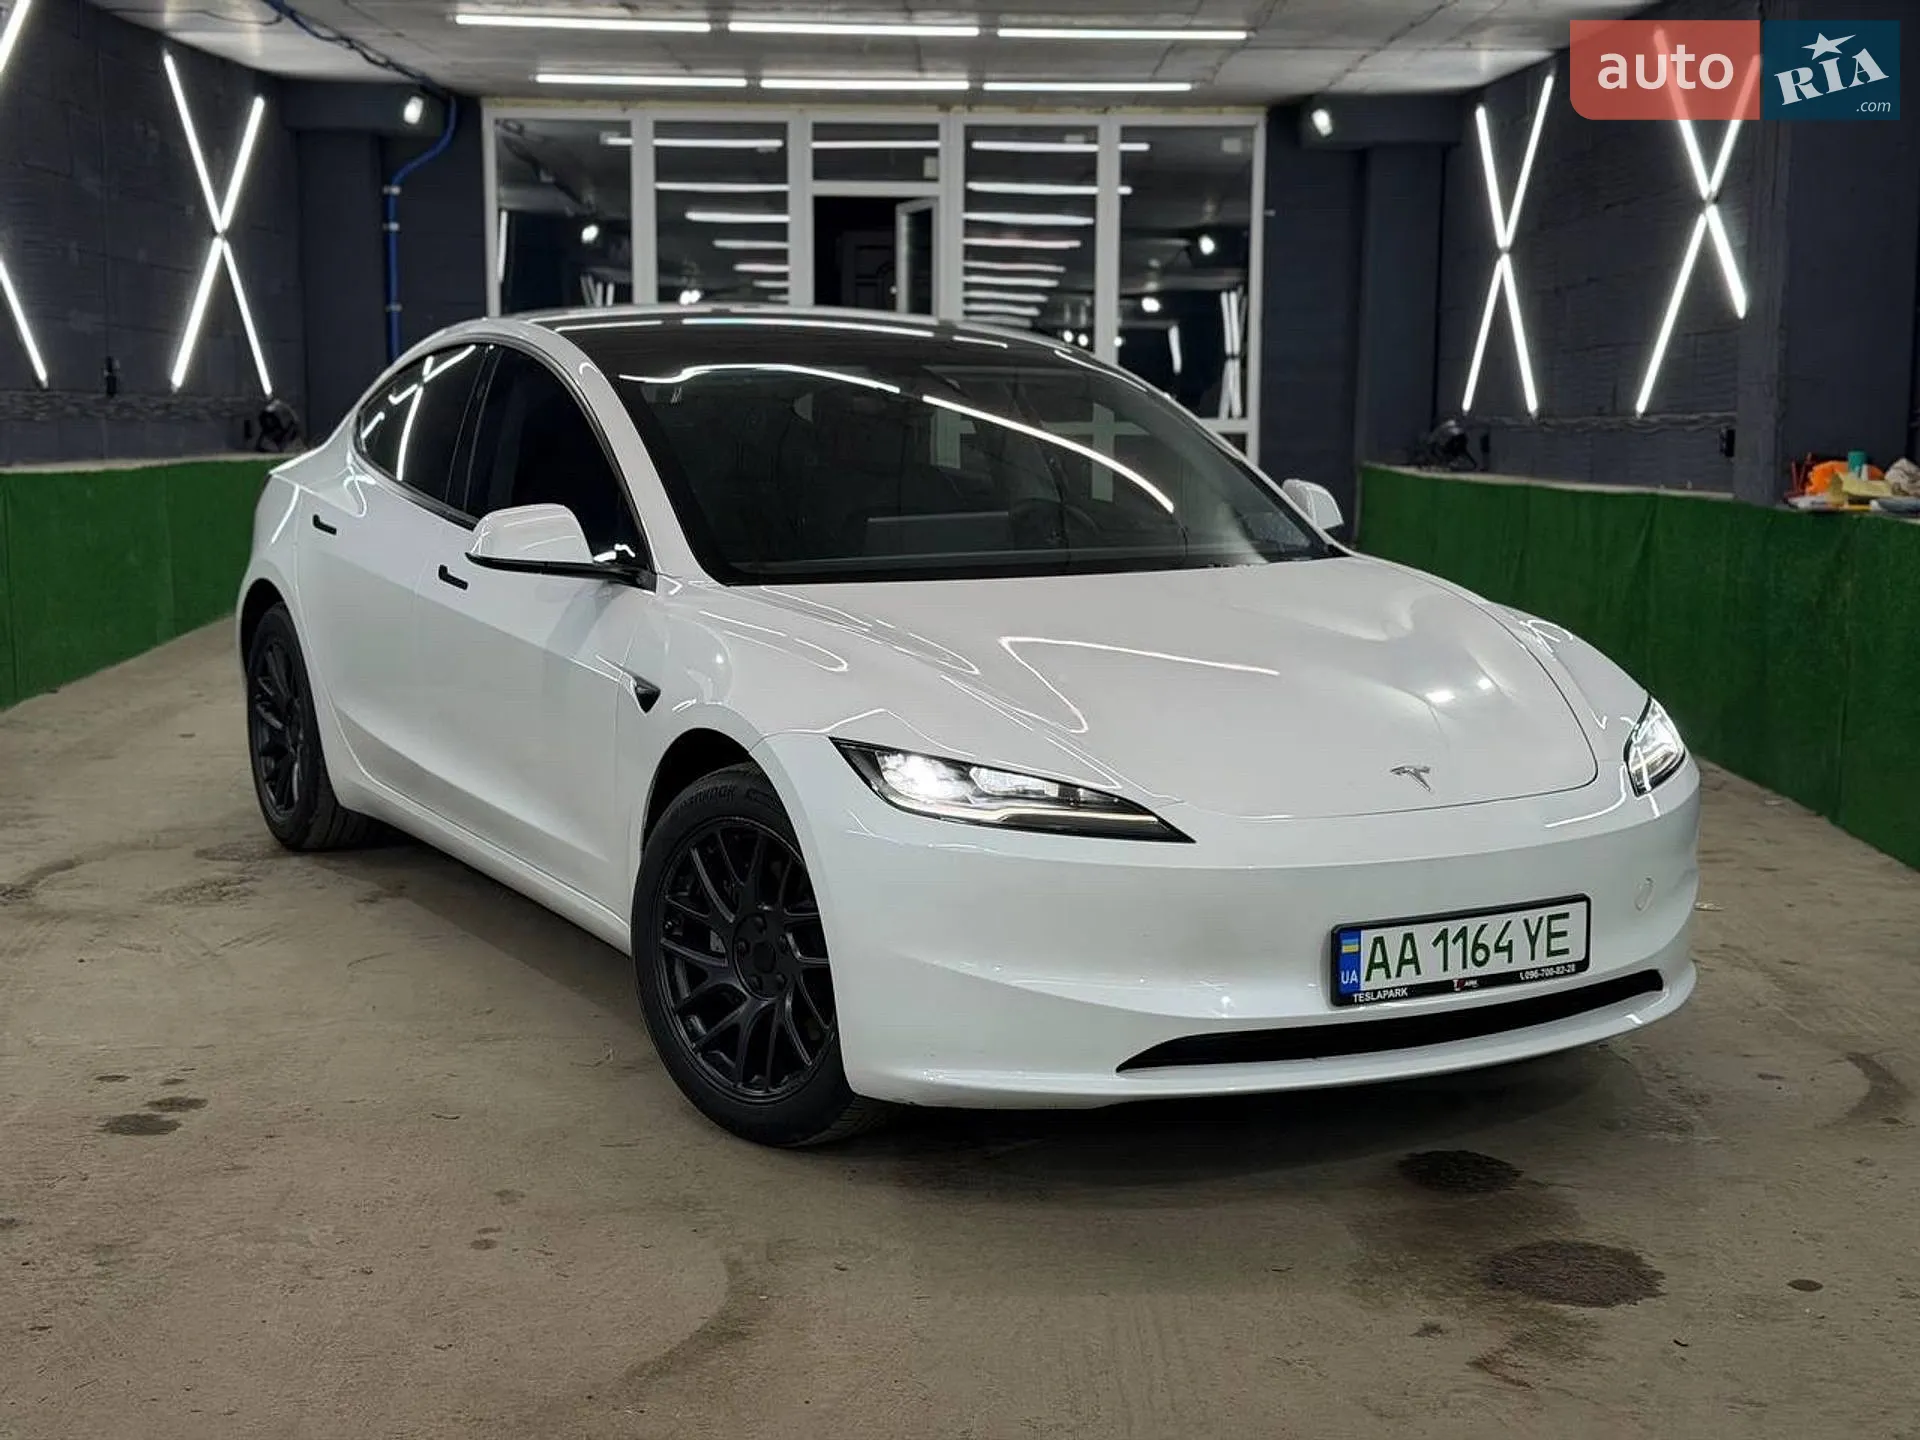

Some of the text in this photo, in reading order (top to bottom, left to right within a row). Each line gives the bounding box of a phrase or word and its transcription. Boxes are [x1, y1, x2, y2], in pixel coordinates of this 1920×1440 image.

[1364, 912, 1570, 982] AA 1164 YE
[1340, 970, 1359, 985] UA
[1352, 986, 1409, 1004] TESLAPARK
